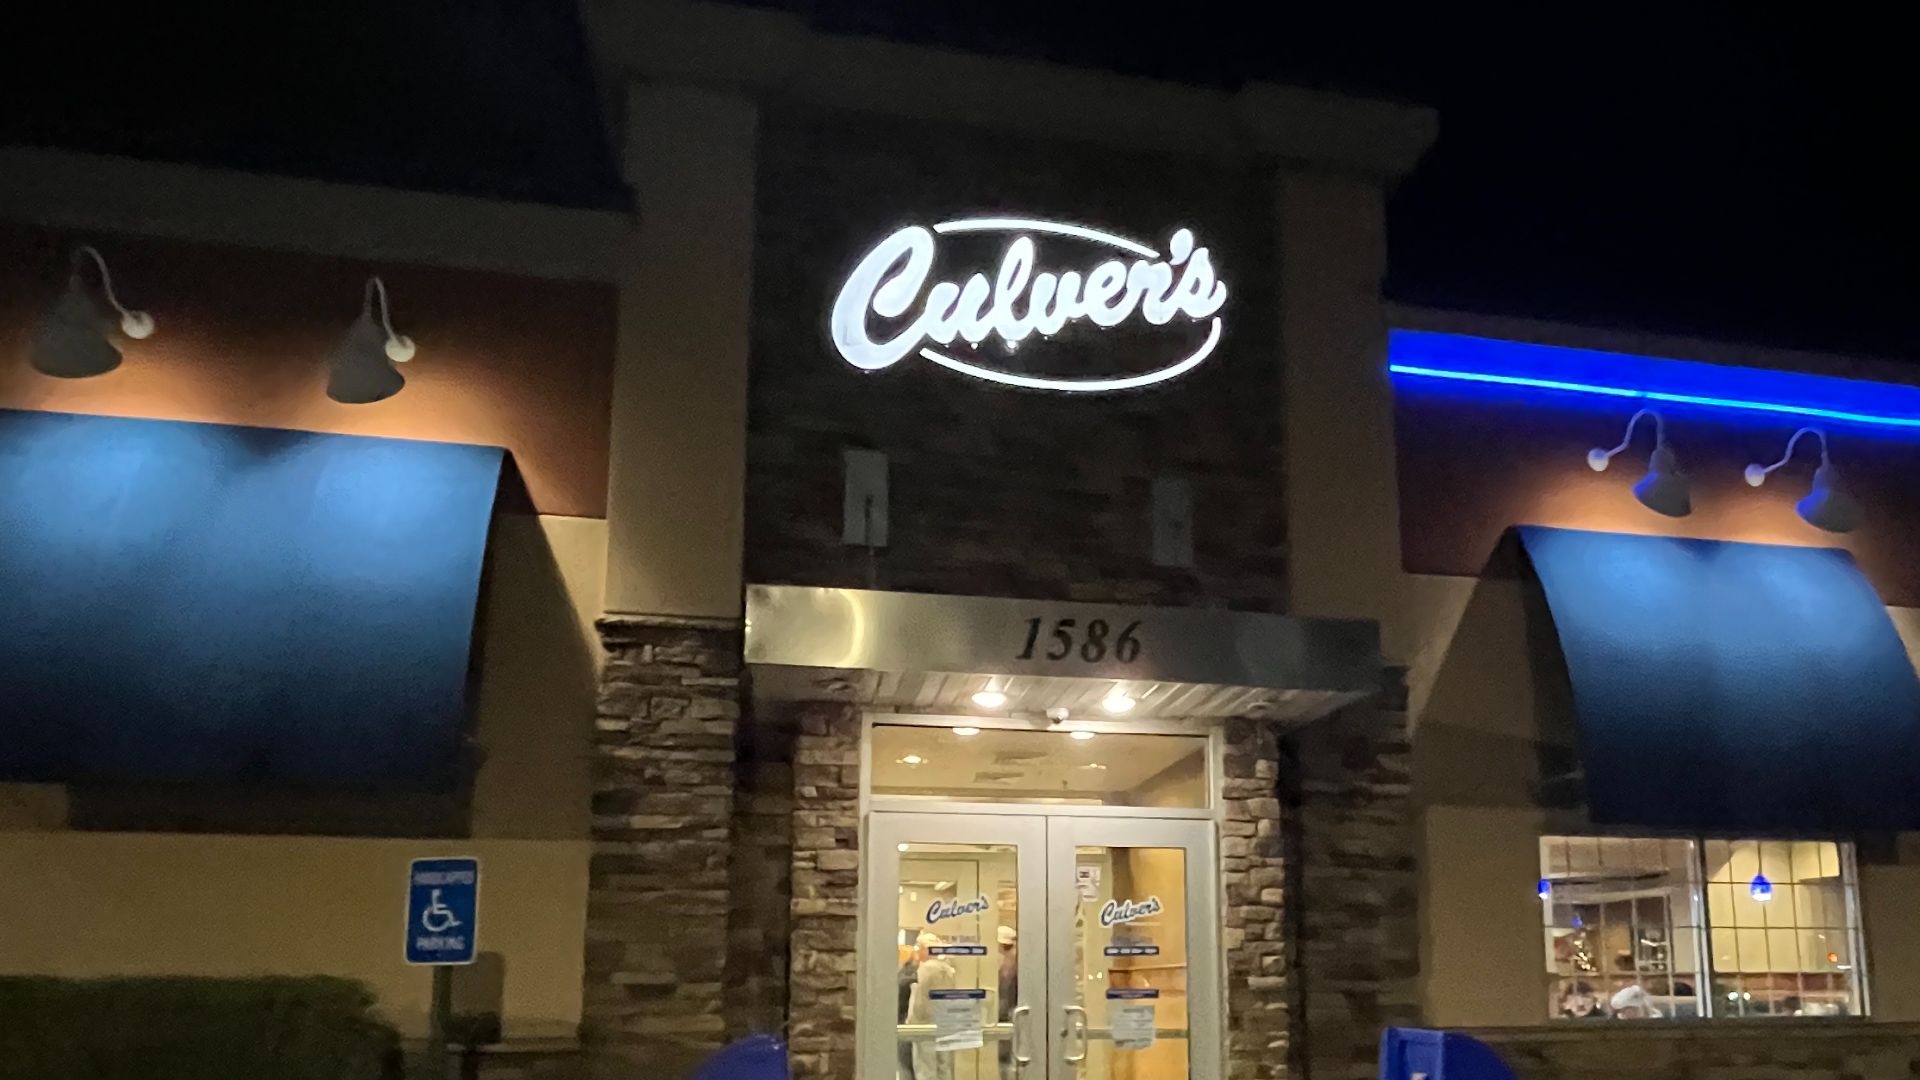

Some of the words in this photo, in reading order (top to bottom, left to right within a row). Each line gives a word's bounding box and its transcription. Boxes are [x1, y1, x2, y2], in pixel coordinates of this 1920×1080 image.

[831, 225, 1227, 370] Culver's
[1015, 617, 1142, 664] 1586
[925, 896, 989, 924] Culver's
[1101, 897, 1161, 926] Culver's
